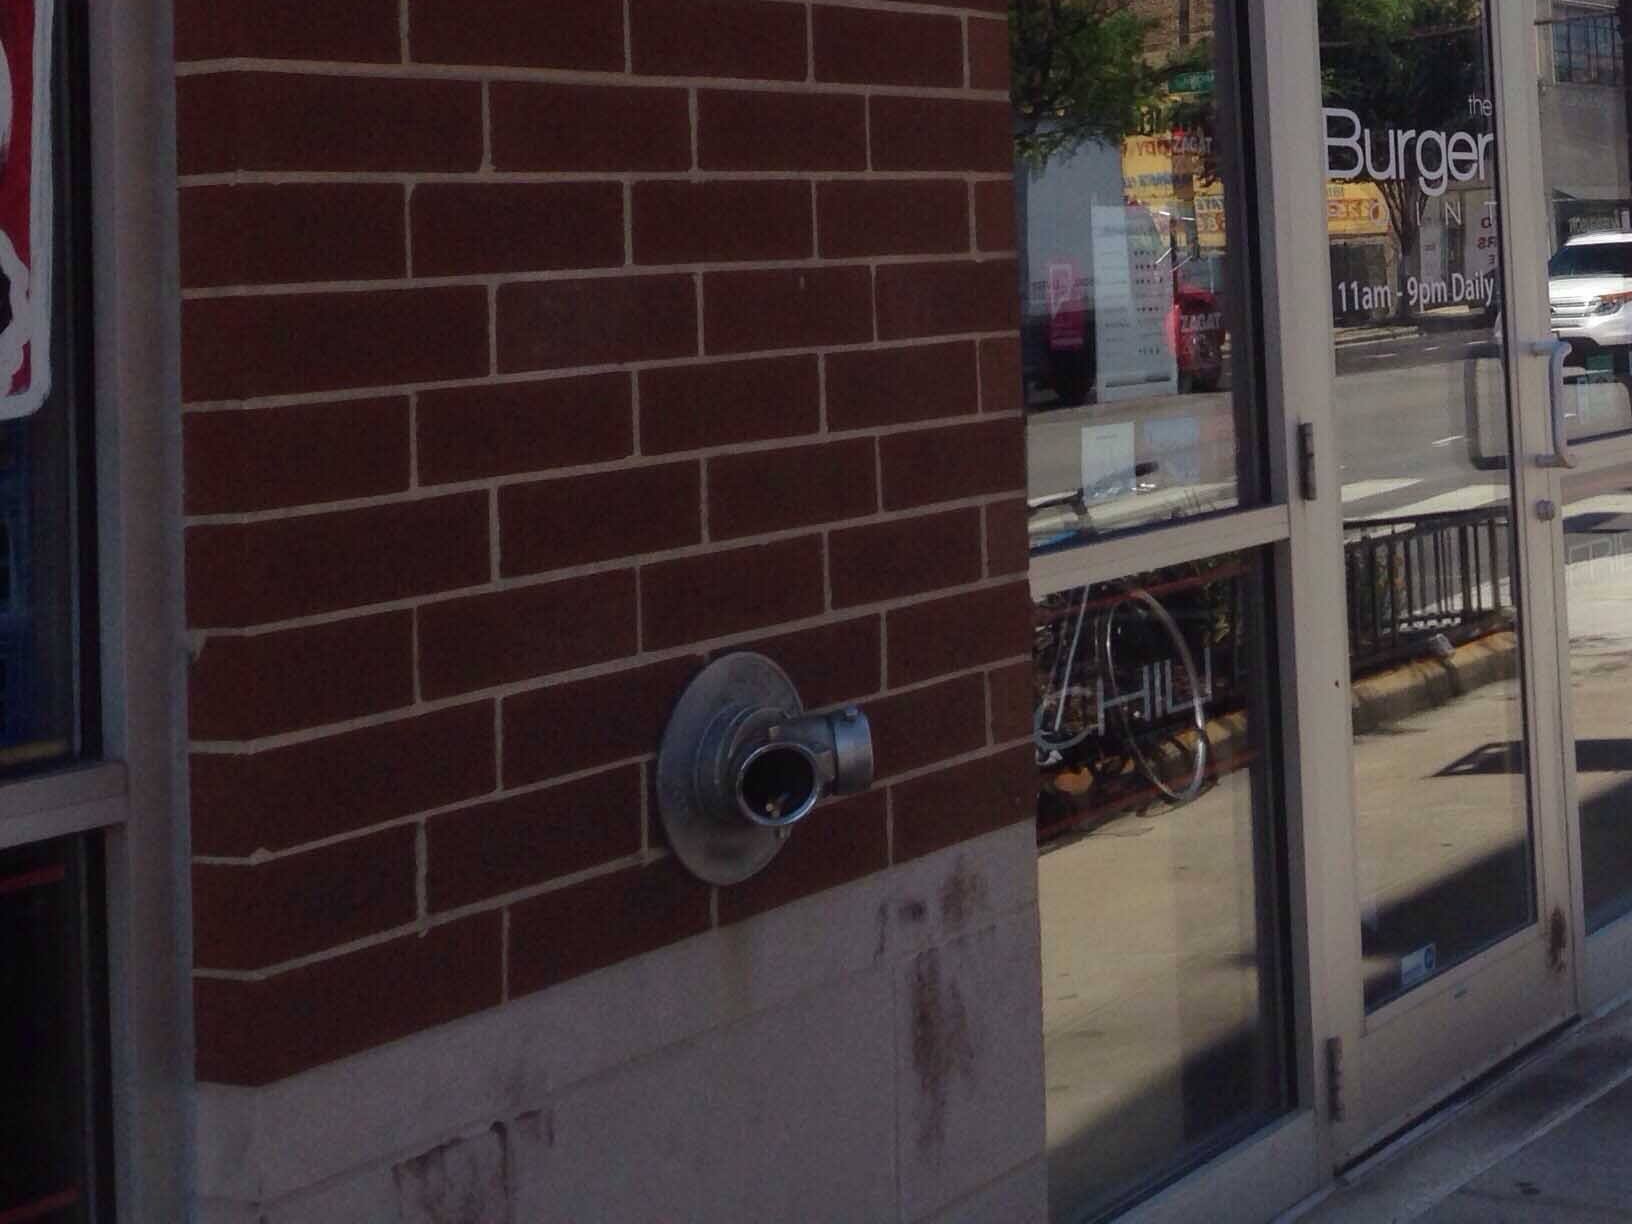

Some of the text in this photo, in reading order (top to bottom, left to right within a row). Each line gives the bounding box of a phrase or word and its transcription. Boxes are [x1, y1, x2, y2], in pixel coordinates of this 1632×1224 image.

[1467, 92, 1493, 117] the
[1320, 107, 1494, 197] Burger
[1338, 281, 1391, 312] 11am
[1407, 277, 1448, 313] 9pm
[1452, 272, 1494, 306] Daily
